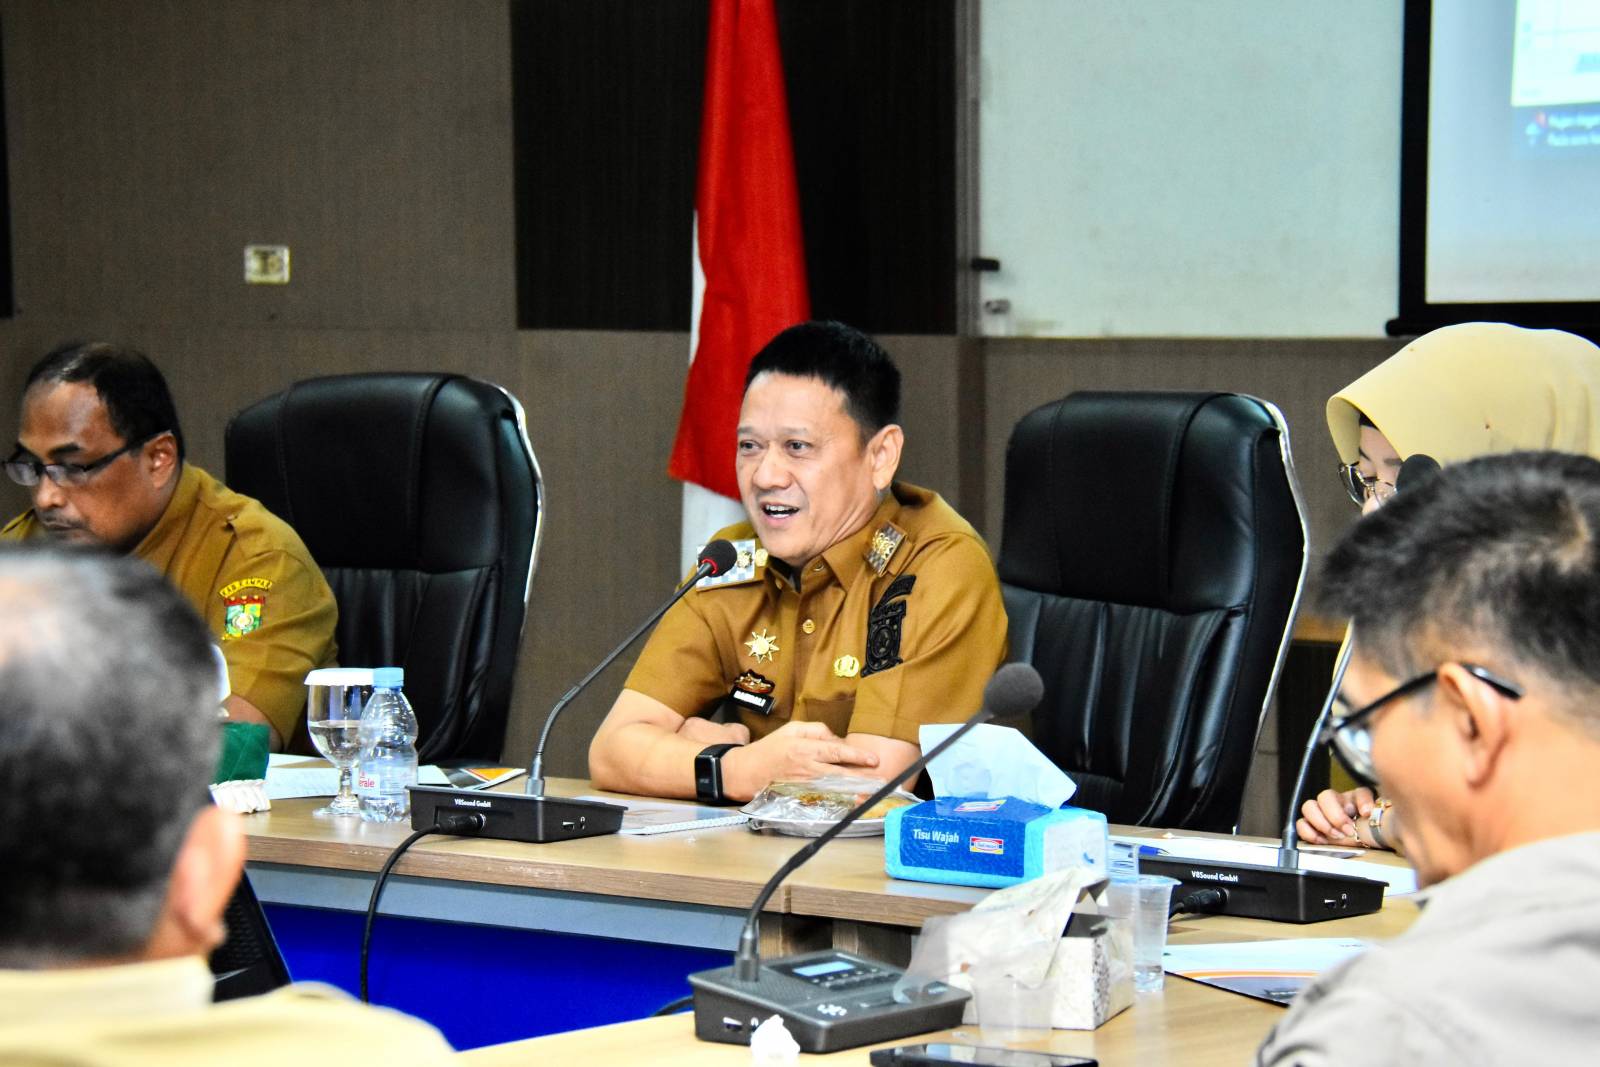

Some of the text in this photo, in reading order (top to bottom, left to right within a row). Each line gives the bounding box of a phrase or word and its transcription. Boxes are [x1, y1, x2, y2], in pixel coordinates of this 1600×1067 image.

[912, 828, 931, 840] Tisu
[932, 830, 960, 845] Wajah
[1191, 870, 1239, 882] V8Sound GmbH
